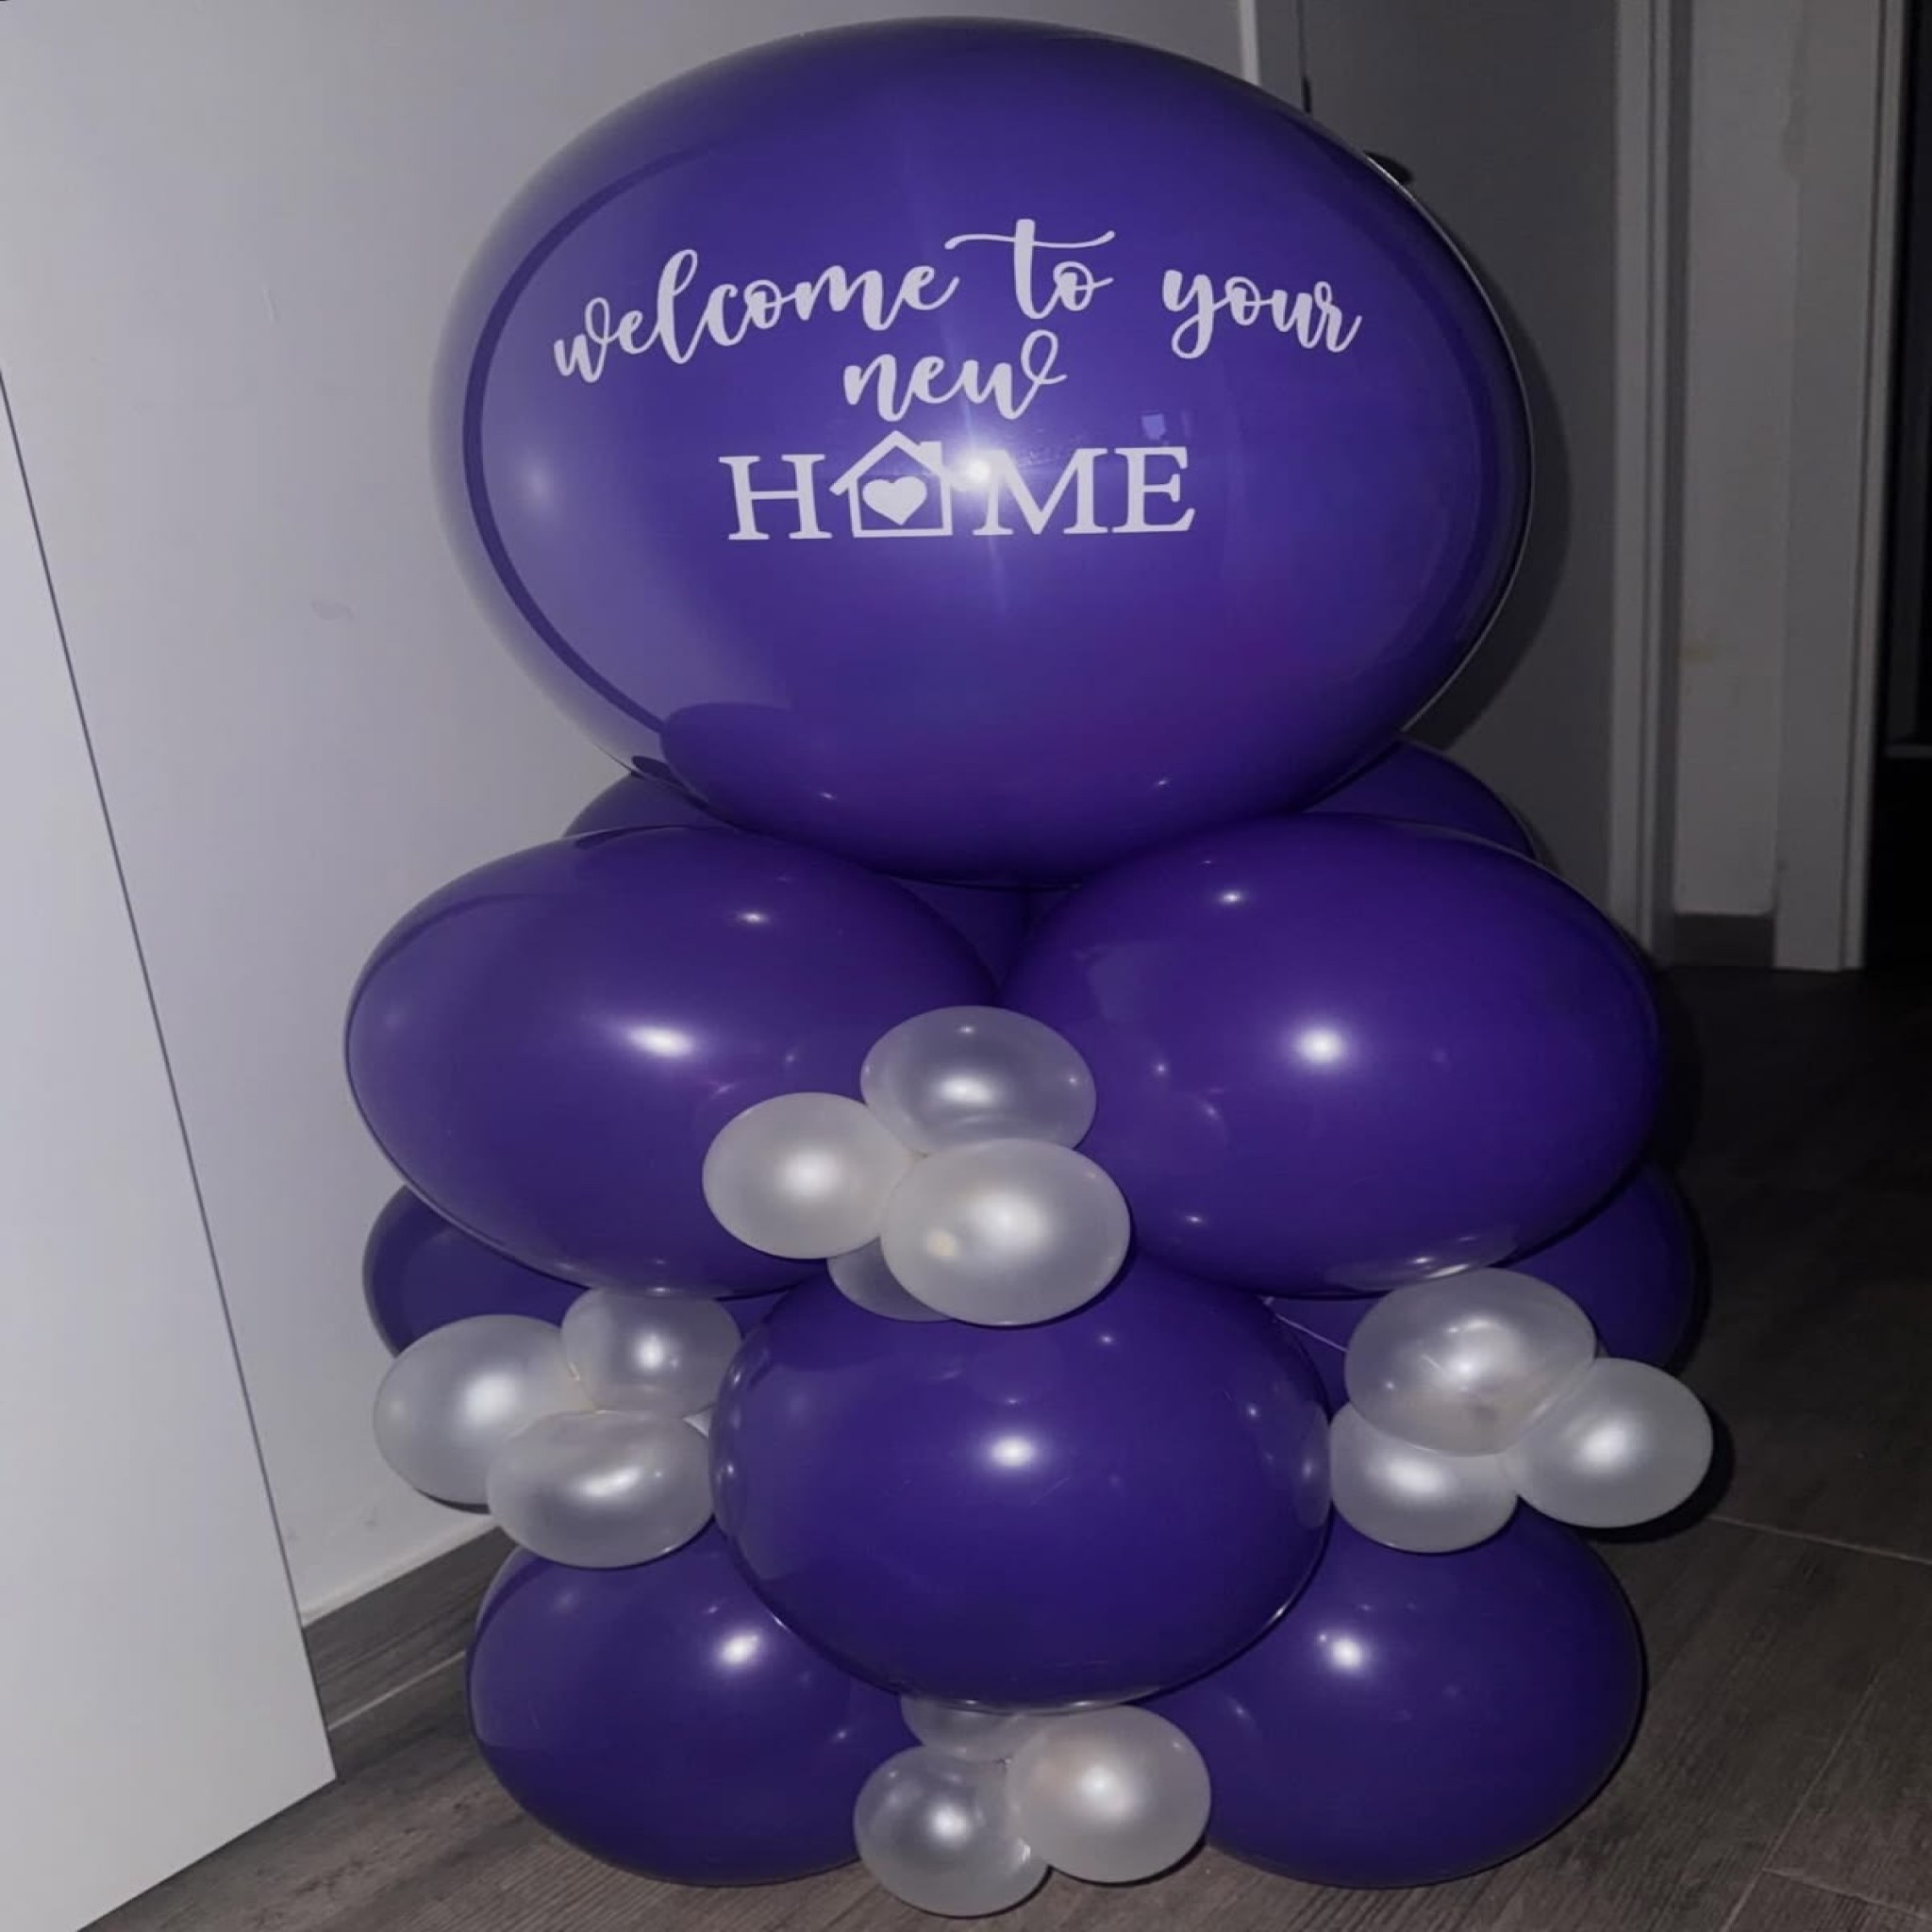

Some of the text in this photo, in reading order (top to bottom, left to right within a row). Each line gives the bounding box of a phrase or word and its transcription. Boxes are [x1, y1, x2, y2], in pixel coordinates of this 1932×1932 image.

[553, 219, 1361, 383] welcome to your
[843, 329, 1067, 423] new
